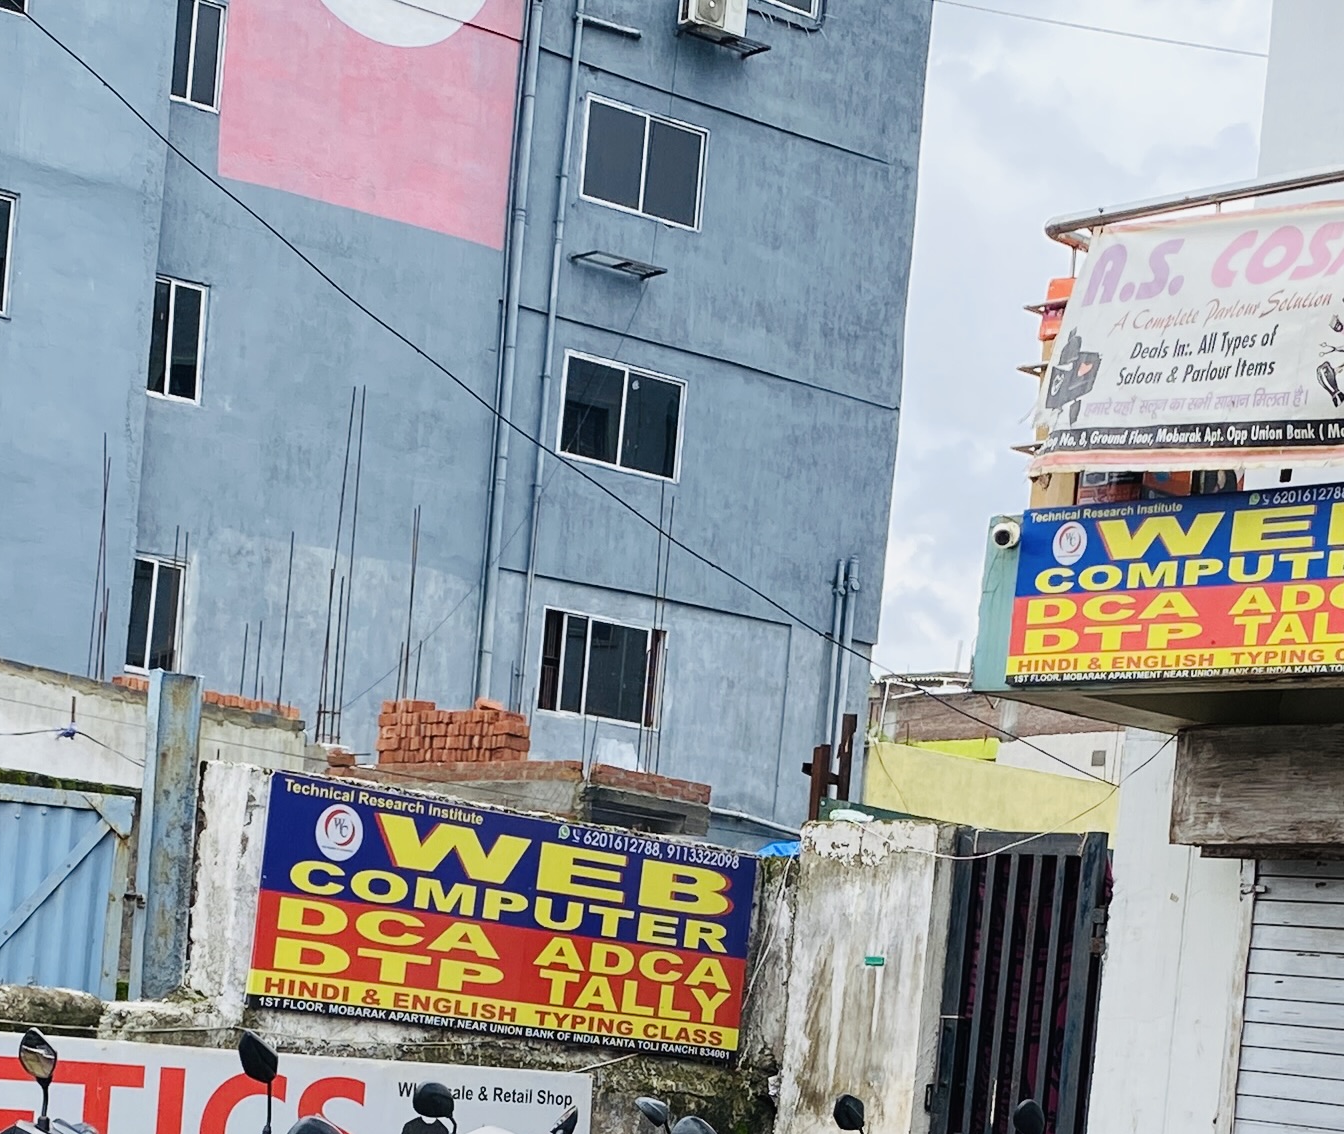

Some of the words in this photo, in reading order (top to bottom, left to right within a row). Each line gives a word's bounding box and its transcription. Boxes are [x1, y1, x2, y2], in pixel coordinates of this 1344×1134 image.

[1130, 337, 1169, 361] Deals
[1220, 328, 1259, 356] Types
[1183, 358, 1232, 383] Parlour
[1235, 358, 1276, 379] Items
[1090, 429, 1127, 446] Ground
[1156, 427, 1202, 444] Mobarak
[1250, 424, 1284, 440] Union
[1287, 423, 1316, 440] Bank
[1031, 508, 1081, 524] Technical
[1083, 505, 1134, 520] Research
[1136, 501, 1183, 517] Institute
[1026, 591, 1200, 626] DCA
[1023, 622, 1204, 655] DTP
[1017, 657, 1079, 673] HINDI
[1112, 652, 1215, 671] ENGLISH
[1230, 647, 1328, 667] TYPING
[284, 778, 355, 804] Technical
[357, 792, 425, 816] Research
[427, 803, 484, 826] Institute
[375, 811, 734, 918] WEB
[583, 830, 663, 860] 6201612788,
[666, 844, 740, 870] 9113322098
[289, 860, 728, 954] COMPUTER
[276, 896, 501, 961] DCA
[532, 936, 732, 992] ADCA
[272, 936, 505, 993] DTP
[539, 968, 732, 1026] TALLY
[259, 996, 281, 1010] 1ST
[328, 1003, 387, 1022] MOBARAK
[489, 1024, 524, 1037] UNION
[525, 1027, 555, 1041] BANK
[557, 1031, 571, 1042] OF
[572, 1033, 601, 1046] INDIA
[602, 1037, 636, 1049] KANTA
[637, 1040, 660, 1052] TOLI
[660, 1043, 698, 1056] RANCHI
[699, 1046, 731, 1060] 834001
[264, 977, 350, 1003] HINDI
[361, 988, 382, 1007] &
[393, 991, 518, 1023] ENGLISH
[535, 1009, 633, 1037] TYPING
[642, 1024, 724, 1047] CLASS
[478, 1086, 488, 1102] &
[493, 1087, 533, 1104] Retail
[536, 1089, 573, 1108] Shop
